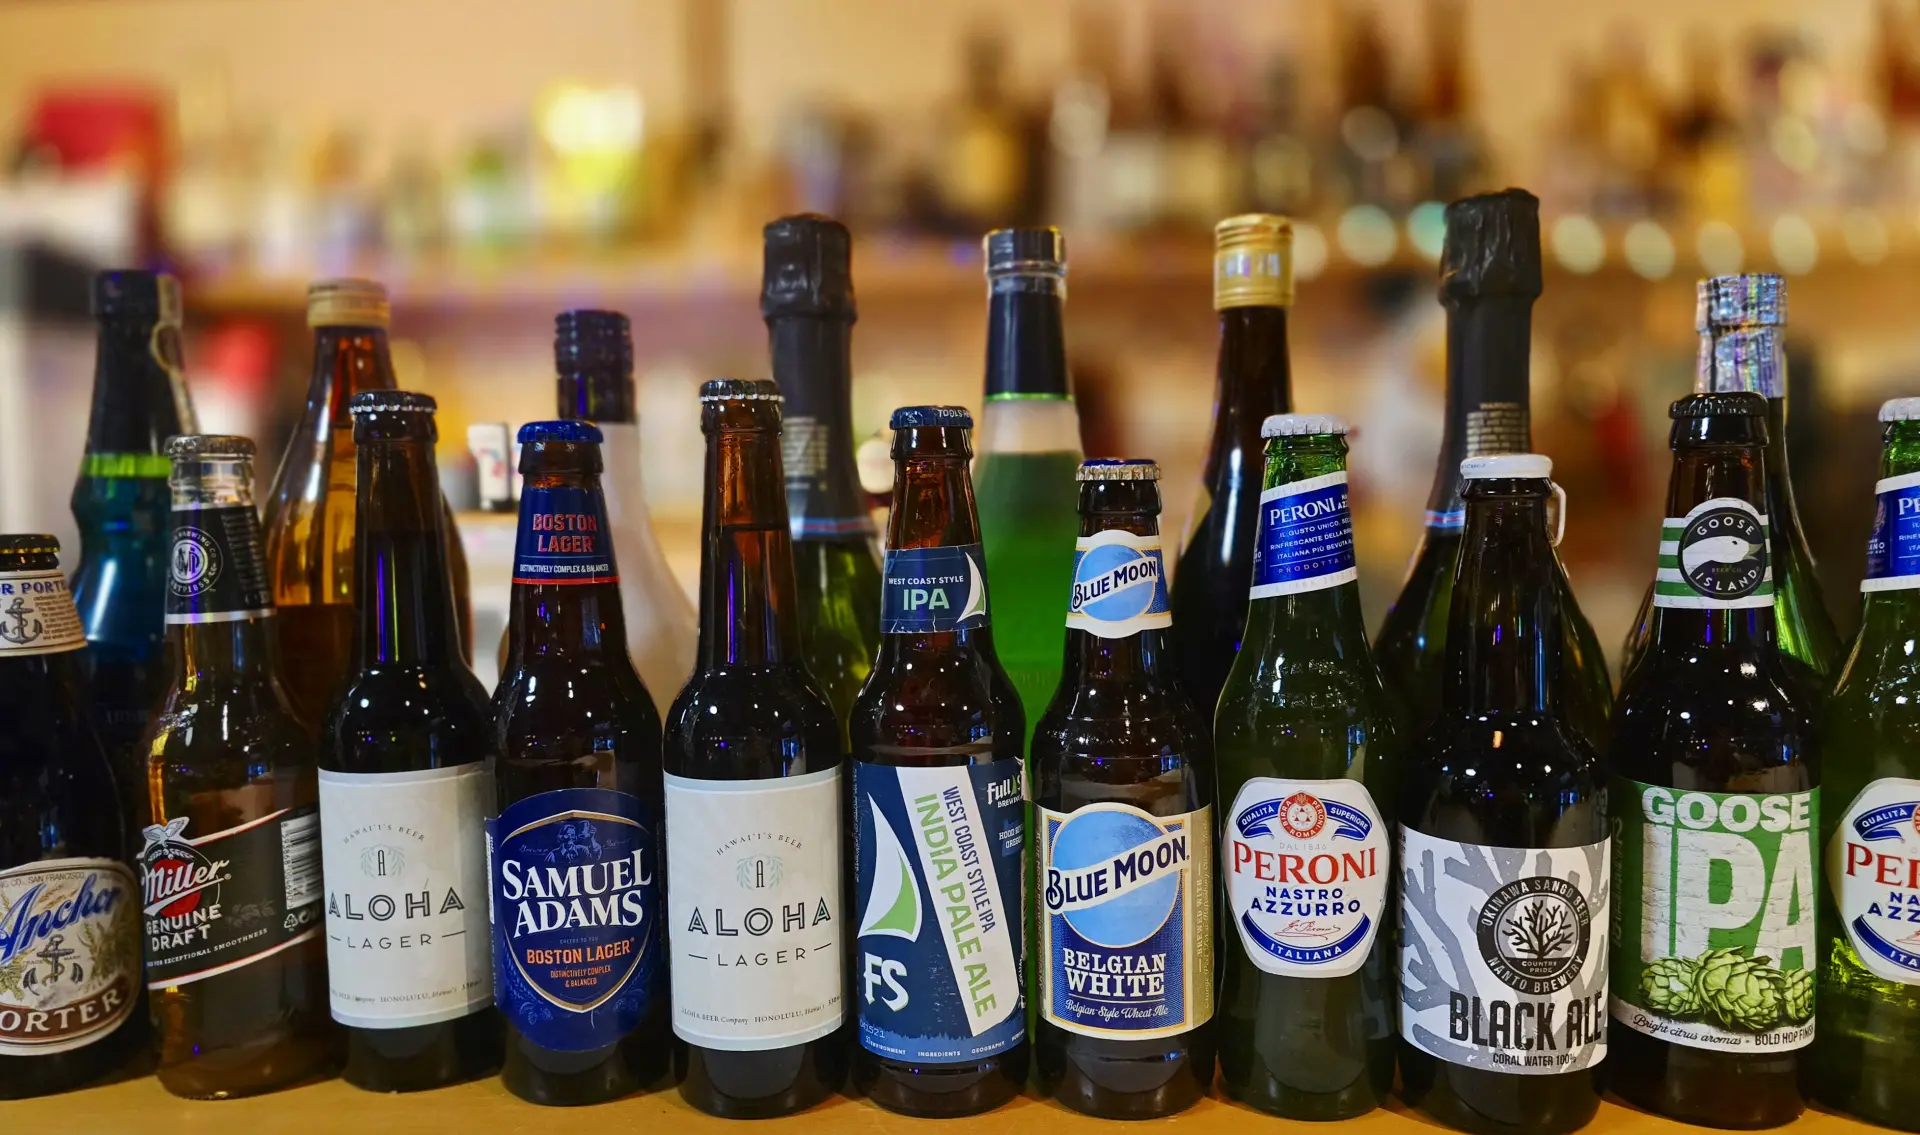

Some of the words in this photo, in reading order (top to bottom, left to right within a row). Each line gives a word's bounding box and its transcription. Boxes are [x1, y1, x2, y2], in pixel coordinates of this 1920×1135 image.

[532, 512, 598, 532] BOSTON
[1270, 496, 1336, 526] PERONI
[1288, 526, 1316, 536] GUSTO
[1696, 516, 1754, 536] GOOSE
[536, 534, 596, 552] LAGER
[1270, 536, 1324, 550] RINFRESCANTE
[1277, 550, 1310, 560] ITALIANA
[520, 564, 554, 573] DISTINCTIVELY
[553, 564, 581, 574] COMPLEX
[1278, 558, 1340, 574] PRODOTTA
[888, 577, 906, 586] WEST
[907, 577, 938, 585] COAST
[938, 575, 964, 584] STYLE
[1072, 576, 1110, 610] BLUE
[1113, 560, 1158, 589] MOON
[1696, 569, 1758, 592] ISLAND
[902, 588, 950, 611] IPA
[942, 785, 968, 824] WEST
[986, 778, 1012, 806] Full
[1241, 804, 1275, 826] QUALITÀ
[1330, 806, 1369, 831] SUPERIORE
[1280, 800, 1293, 826] BIRRA
[1312, 800, 1324, 828] PERONI
[1641, 786, 1812, 833] GOOSE
[1862, 806, 1908, 828] QUALITÀ
[398, 826, 426, 842] BEER
[778, 834, 804, 850] BEER
[1279, 841, 1300, 851] DAL
[1289, 828, 1316, 838] ROMA
[954, 826, 980, 868] COAST
[502, 848, 652, 900] SAMUEL
[1045, 868, 1108, 911] BLUE
[1114, 836, 1187, 892] MOON
[1233, 840, 1376, 885] PERONI
[28, 875, 45, 884] SAN
[140, 860, 230, 908] Miller
[967, 868, 991, 912] STYLE
[328, 886, 466, 922] ALOHA
[914, 792, 960, 882] INDIA
[940, 880, 982, 960] PALE
[964, 962, 998, 1019] ALE
[1266, 886, 1344, 900] NASTRO
[1481, 880, 1530, 928] OKINAWA
[1534, 878, 1574, 899] SANGO
[1572, 896, 1589, 928] BEER
[1640, 822, 1816, 972] IPA
[0, 872, 122, 966] Anchor
[146, 904, 222, 936] GENUINE
[513, 890, 644, 939] ADAMS
[687, 896, 832, 937] ALOHA
[1250, 897, 1361, 917] AZZURRO
[978, 908, 996, 934] IPA
[152, 924, 212, 952] DRAFT
[164, 948, 212, 966] EXCEPTIONAL
[213, 928, 268, 952] SMOOTHNESS
[346, 933, 432, 950] LAGER
[1270, 942, 1343, 960] ITALIANA
[526, 948, 583, 964] BOSTON
[586, 939, 631, 962] LAGER
[717, 947, 806, 968] LAGER
[1062, 946, 1167, 974] BELGIAN
[550, 968, 587, 979] DISTINCTIVELY
[587, 964, 612, 976] COMPLEX
[570, 977, 598, 988] BALANCED
[862, 952, 910, 1012] FS
[1064, 966, 1166, 997] WHITE
[1486, 956, 1528, 990] NANTO
[1533, 955, 1584, 994] BREWERY
[702, 1014, 720, 1023] BEER
[720, 1015, 749, 1026] Company
[754, 1010, 804, 1024] HONOLULU,
[1120, 1004, 1151, 1020] Wheat
[1152, 1004, 1170, 1017] Ale
[1450, 990, 1556, 1051] BLACK
[1566, 990, 1603, 1050] ALE
[1632, 1013, 1669, 1038] Bright
[1670, 1026, 1698, 1041] citrus
[1700, 1032, 1742, 1046] aromas
[1754, 1032, 1780, 1046] BOLD
[1782, 1030, 1798, 1045] HOP
[870, 1040, 907, 1056] ENVIRONMENT
[918, 1050, 962, 1058] INGREDIENTS
[971, 1040, 1006, 1055] GEOGRAPHY
[1492, 1052, 1522, 1066] CORAL
[1524, 1054, 1554, 1068] WATER
[1556, 1053, 1578, 1066] 100%
